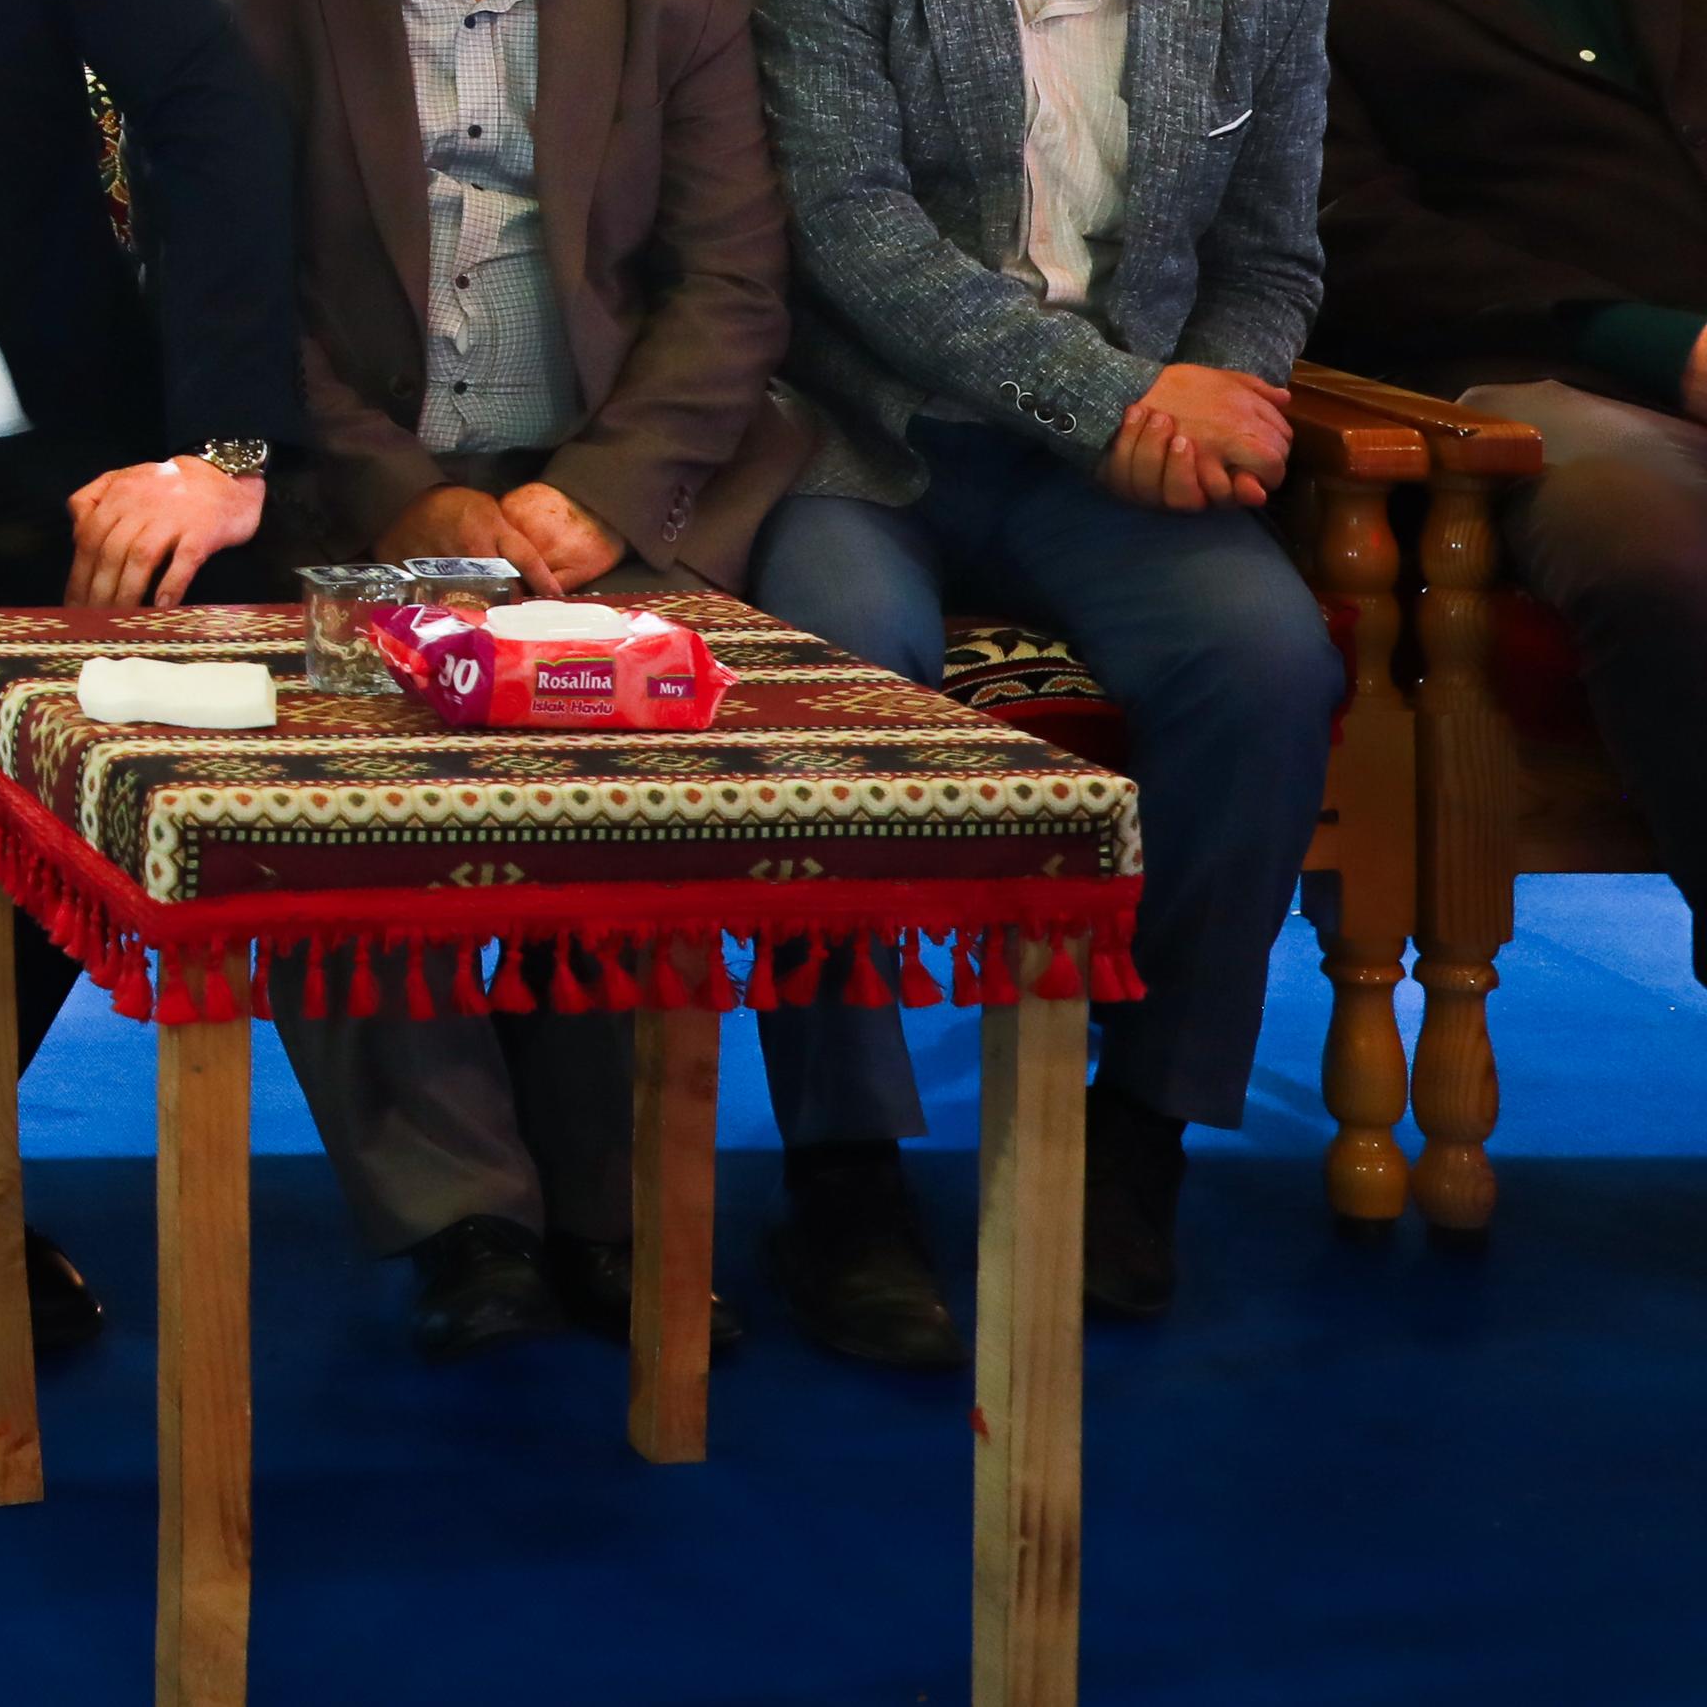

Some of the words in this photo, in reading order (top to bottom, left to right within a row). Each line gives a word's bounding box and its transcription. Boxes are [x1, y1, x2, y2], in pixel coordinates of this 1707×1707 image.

[537, 671, 613, 691] Rosalina
[659, 682, 685, 698] Mry
[532, 699, 566, 714] Islak
[570, 700, 614, 715] Havlu
